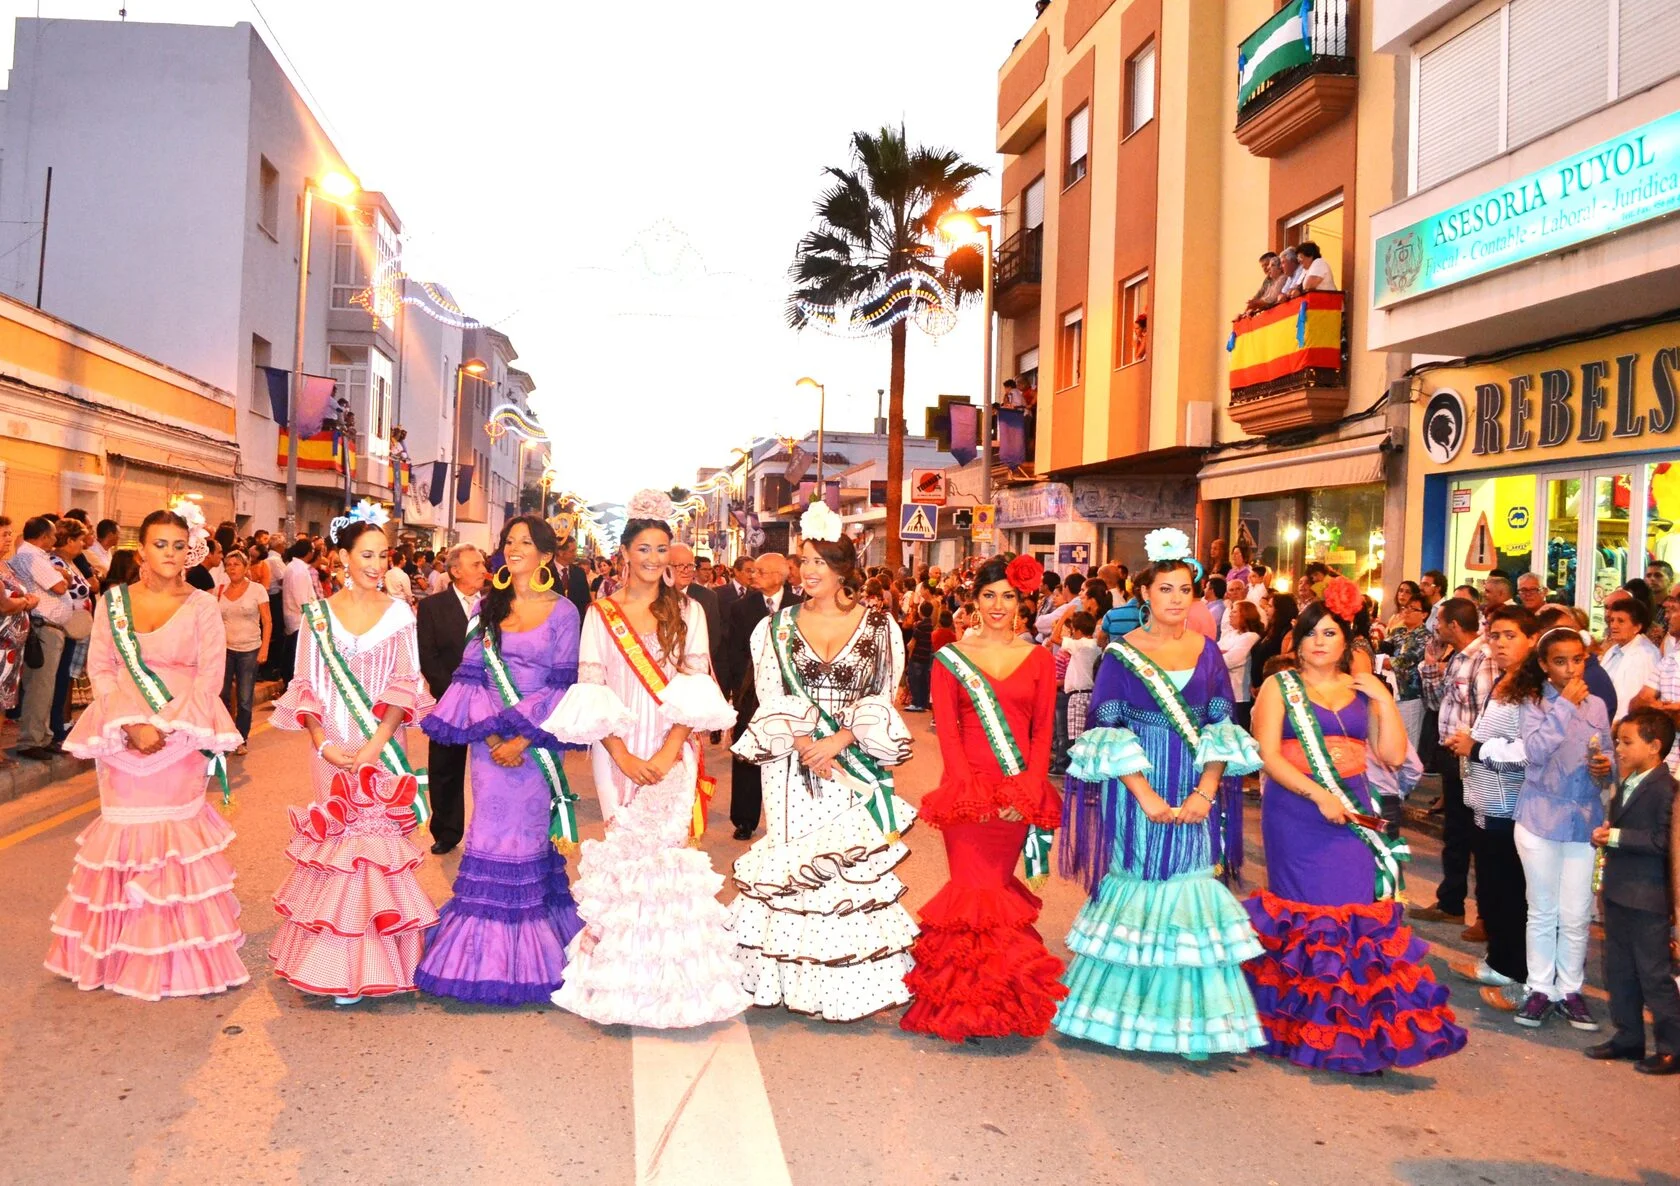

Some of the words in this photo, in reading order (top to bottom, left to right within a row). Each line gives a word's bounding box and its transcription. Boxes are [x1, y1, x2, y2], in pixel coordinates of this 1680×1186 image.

[1425, 253, 1459, 277] Fiscal
[1470, 226, 1526, 261] Contable
[1541, 196, 1597, 236] Laboral
[1434, 178, 1547, 247] ASESORIA
[1560, 134, 1656, 200] PUYOL
[1472, 346, 1680, 455] REBELS
